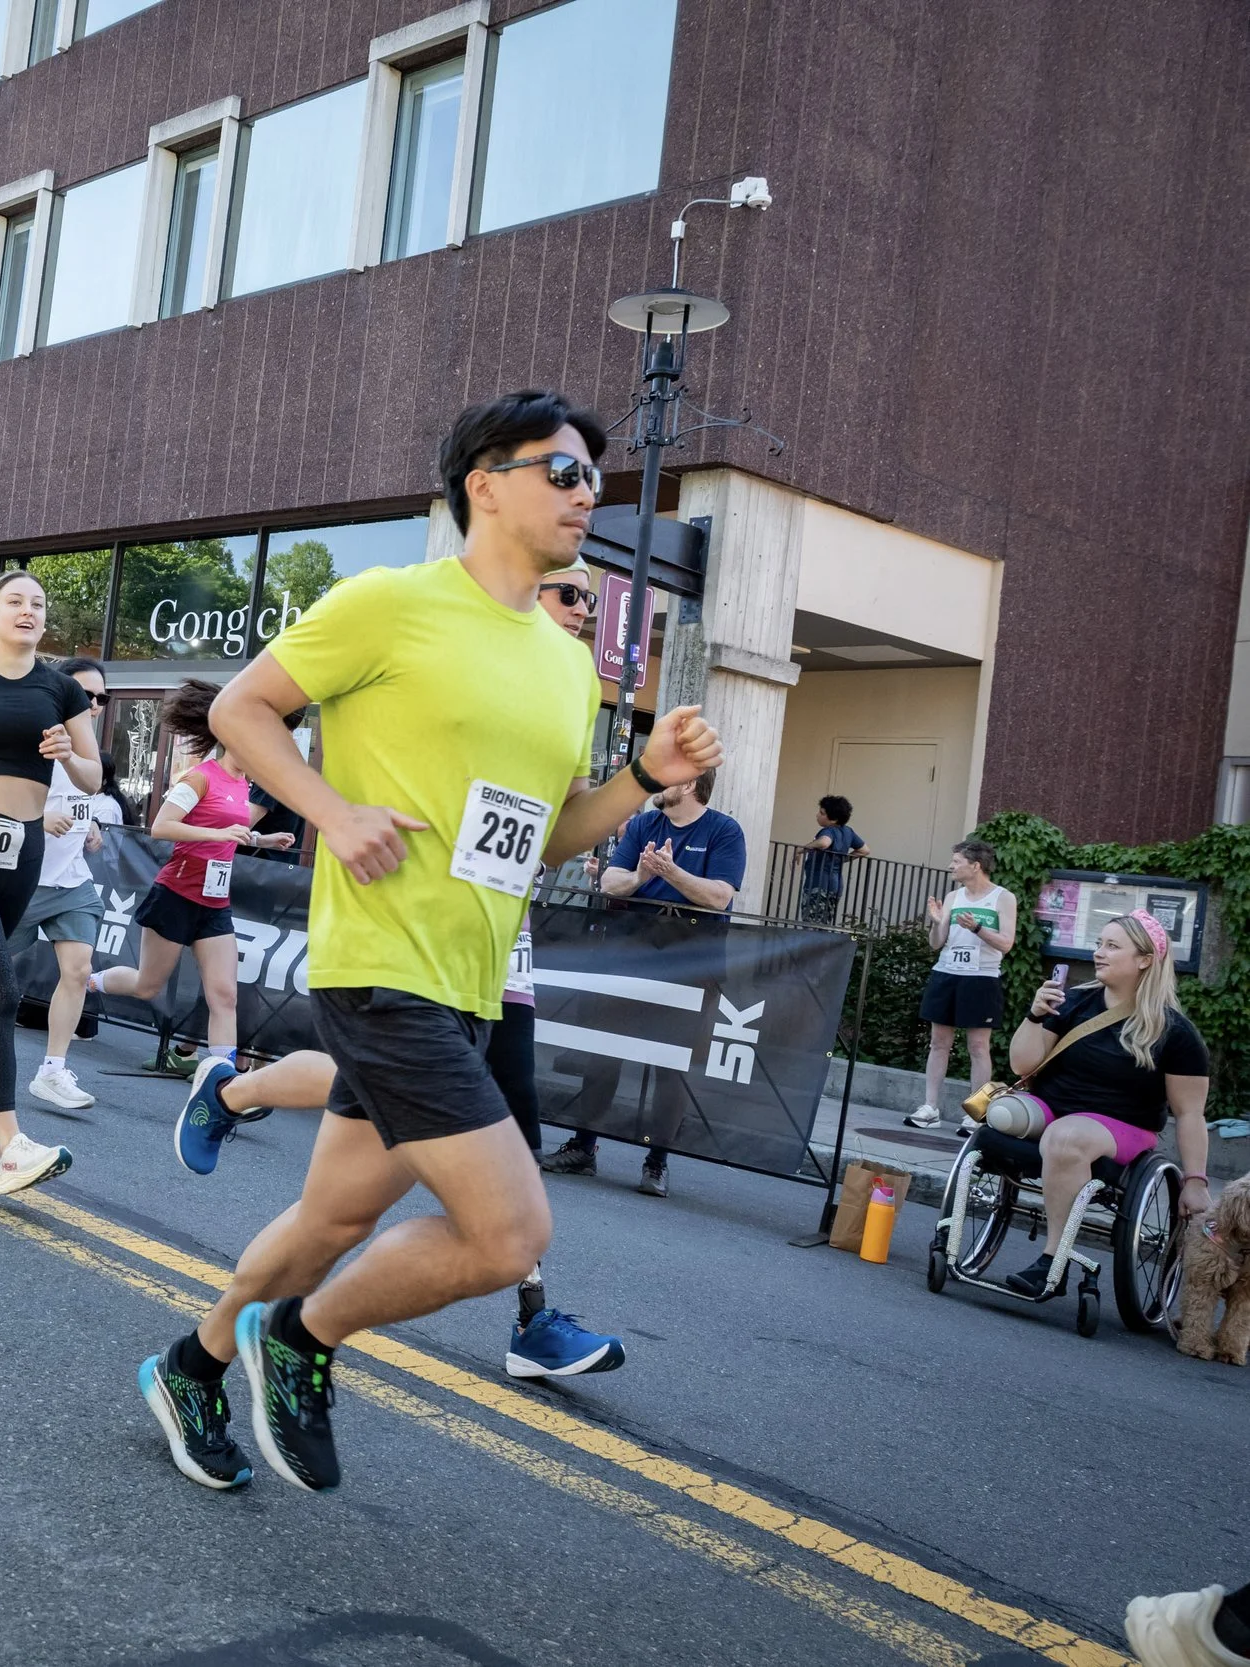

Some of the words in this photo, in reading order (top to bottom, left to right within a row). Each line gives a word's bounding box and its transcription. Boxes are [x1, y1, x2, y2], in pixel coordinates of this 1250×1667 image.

[150, 599, 249, 656] Gong
[256, 590, 302, 639] ch
[604, 649, 624, 666] Gon
[71, 803, 90, 820] 181
[481, 786, 543, 816] BIONIC
[474, 810, 535, 865] 236
[217, 870, 227, 887] 71
[95, 888, 136, 956] 5K
[952, 951, 971, 963] 713
[704, 993, 766, 1085] 5K
